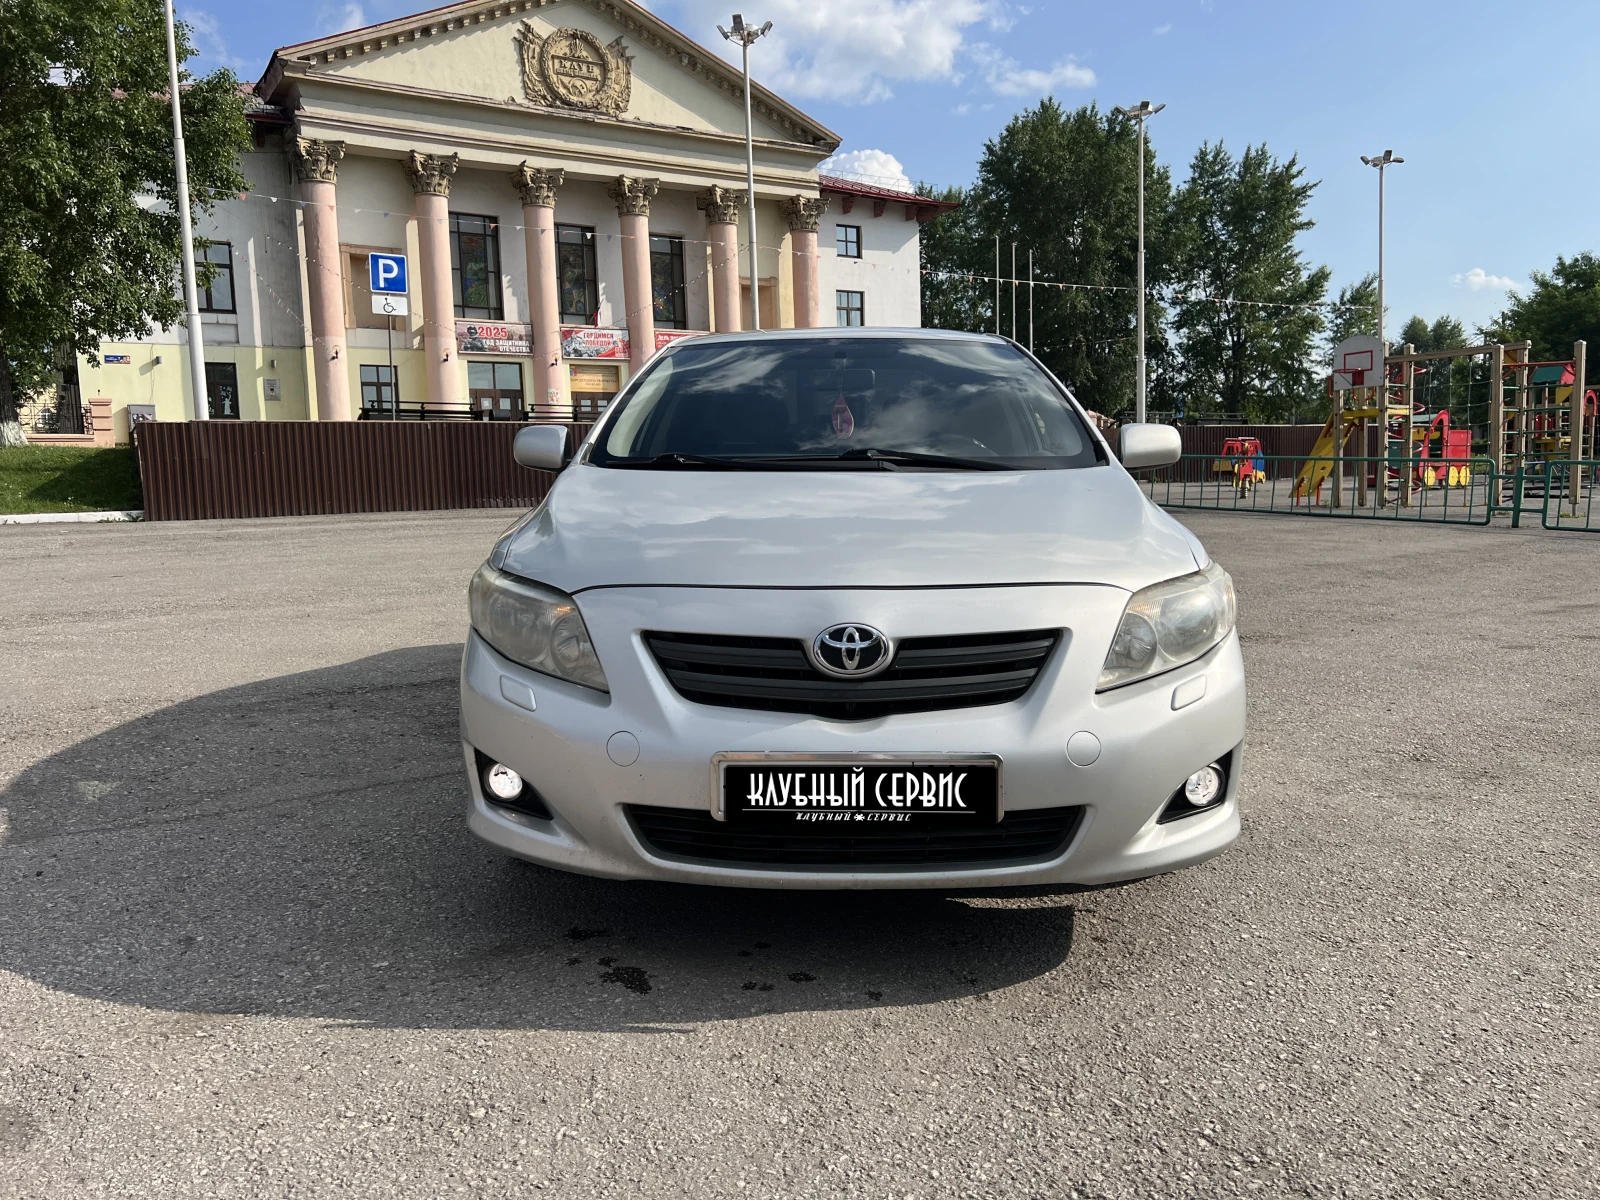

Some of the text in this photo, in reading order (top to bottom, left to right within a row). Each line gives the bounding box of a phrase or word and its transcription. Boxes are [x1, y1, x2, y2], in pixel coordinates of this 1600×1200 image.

[378, 258, 399, 288] P
[478, 326, 508, 338] 2025
[583, 332, 614, 340] ГОРДИМСЯ
[585, 339, 612, 347] ПОБЕДОЙ
